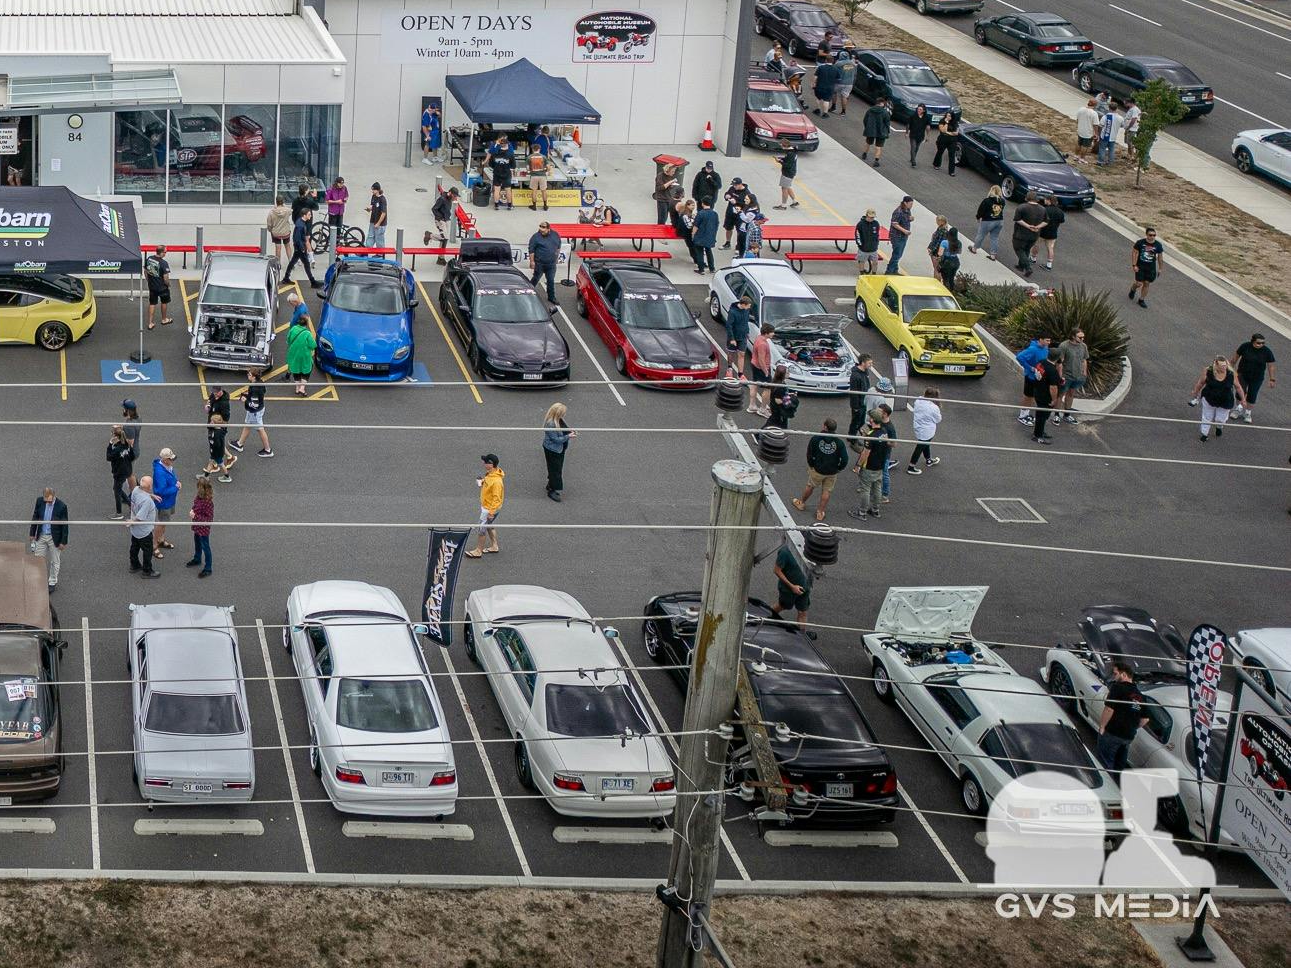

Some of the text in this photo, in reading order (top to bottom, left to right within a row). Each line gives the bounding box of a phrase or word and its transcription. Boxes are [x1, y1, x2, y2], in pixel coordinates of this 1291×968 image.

[400, 15, 533, 31] OPEN 7 DAYS
[438, 36, 460, 46] 9am
[470, 36, 493, 48] 5pm
[416, 48, 451, 58] Winter
[454, 48, 481, 58] 10am
[491, 48, 514, 60] 4pm
[68, 132, 82, 142] 84
[180, 150, 194, 161] STP
[1261, 737, 1273, 750] OF
[1244, 771, 1255, 788] THE
[1256, 785, 1283, 818] ULTIMATE
[1235, 798, 1267, 838] OPEN
[1270, 833, 1277, 846] 7
[1274, 856, 1287, 876] 5pm
